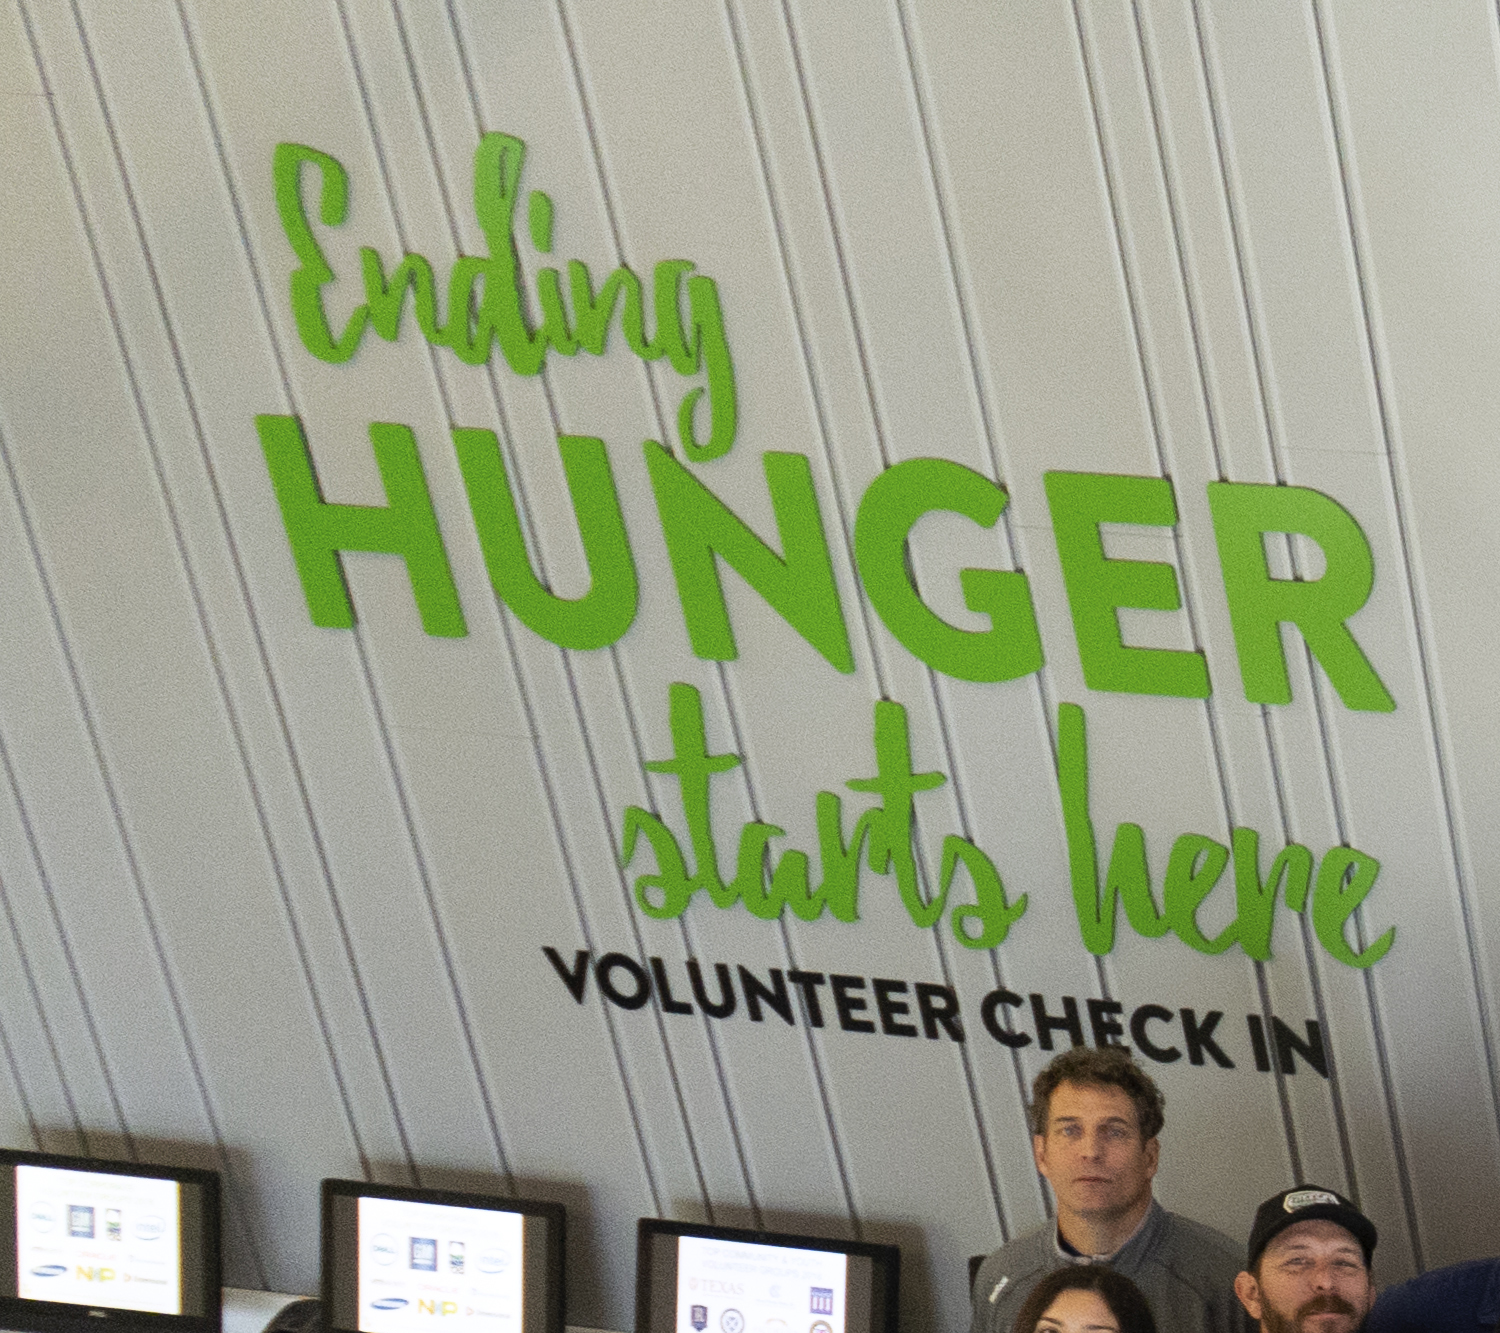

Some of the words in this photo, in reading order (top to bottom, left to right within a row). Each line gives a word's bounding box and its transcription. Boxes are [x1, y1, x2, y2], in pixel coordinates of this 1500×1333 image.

[271, 130, 738, 463] Ending
[253, 413, 1399, 713] HUNGER
[621, 682, 1029, 951] starts
[1057, 702, 1398, 971] here
[540, 945, 968, 1043] VOLUNTEER
[980, 985, 1238, 1072] CHECK
[1245, 1015, 1333, 1080] IN
